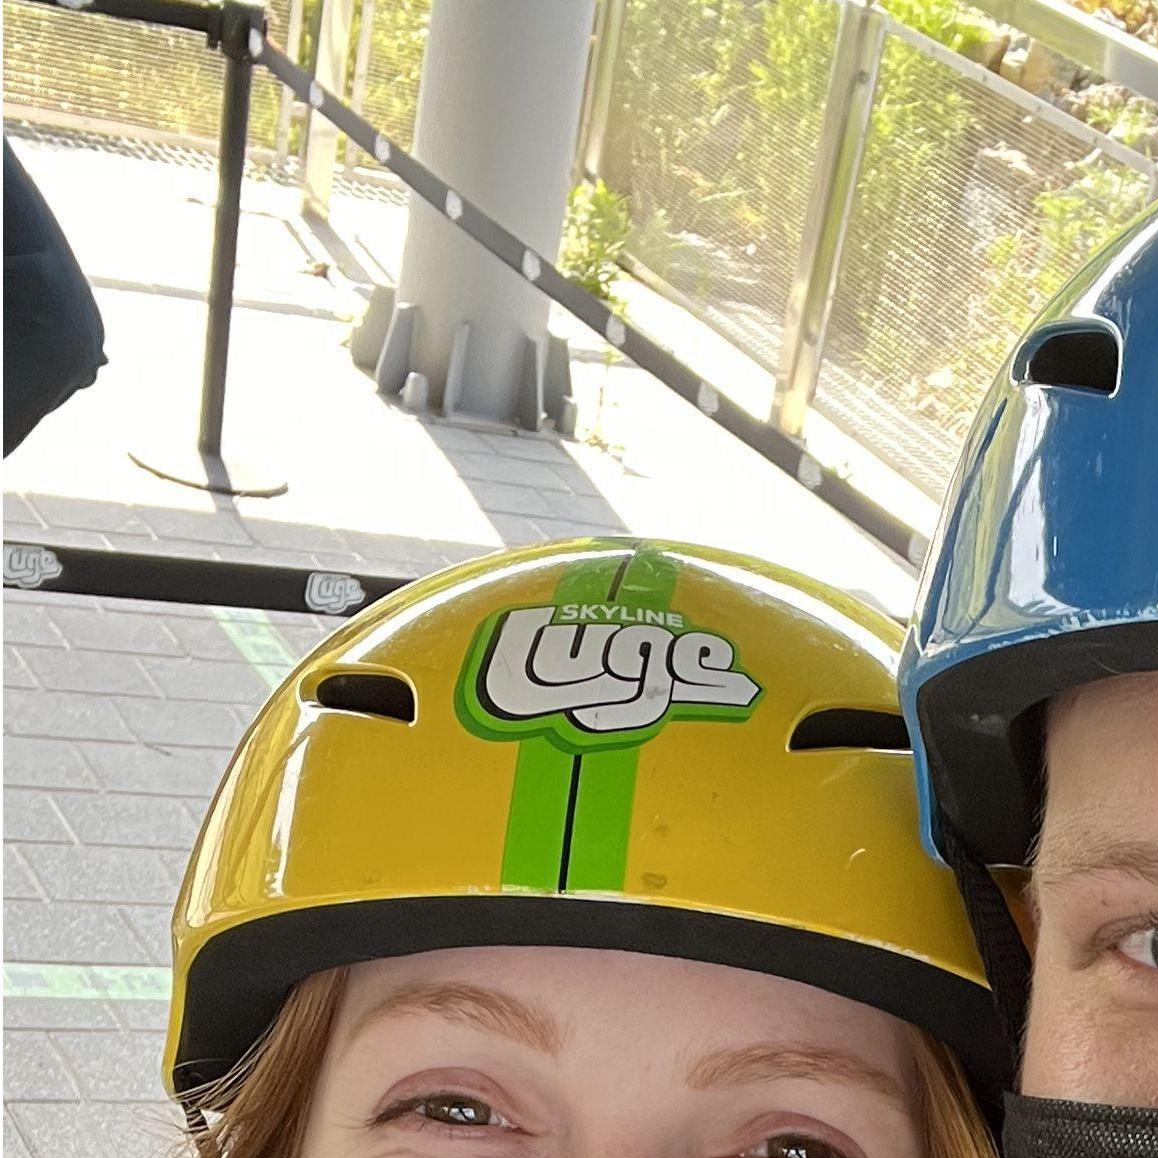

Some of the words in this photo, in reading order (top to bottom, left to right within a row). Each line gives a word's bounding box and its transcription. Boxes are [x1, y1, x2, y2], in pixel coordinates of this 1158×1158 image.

[309, 574, 363, 611] Luge
[560, 603, 684, 628] SKYLINE
[485, 606, 760, 731] Luge
